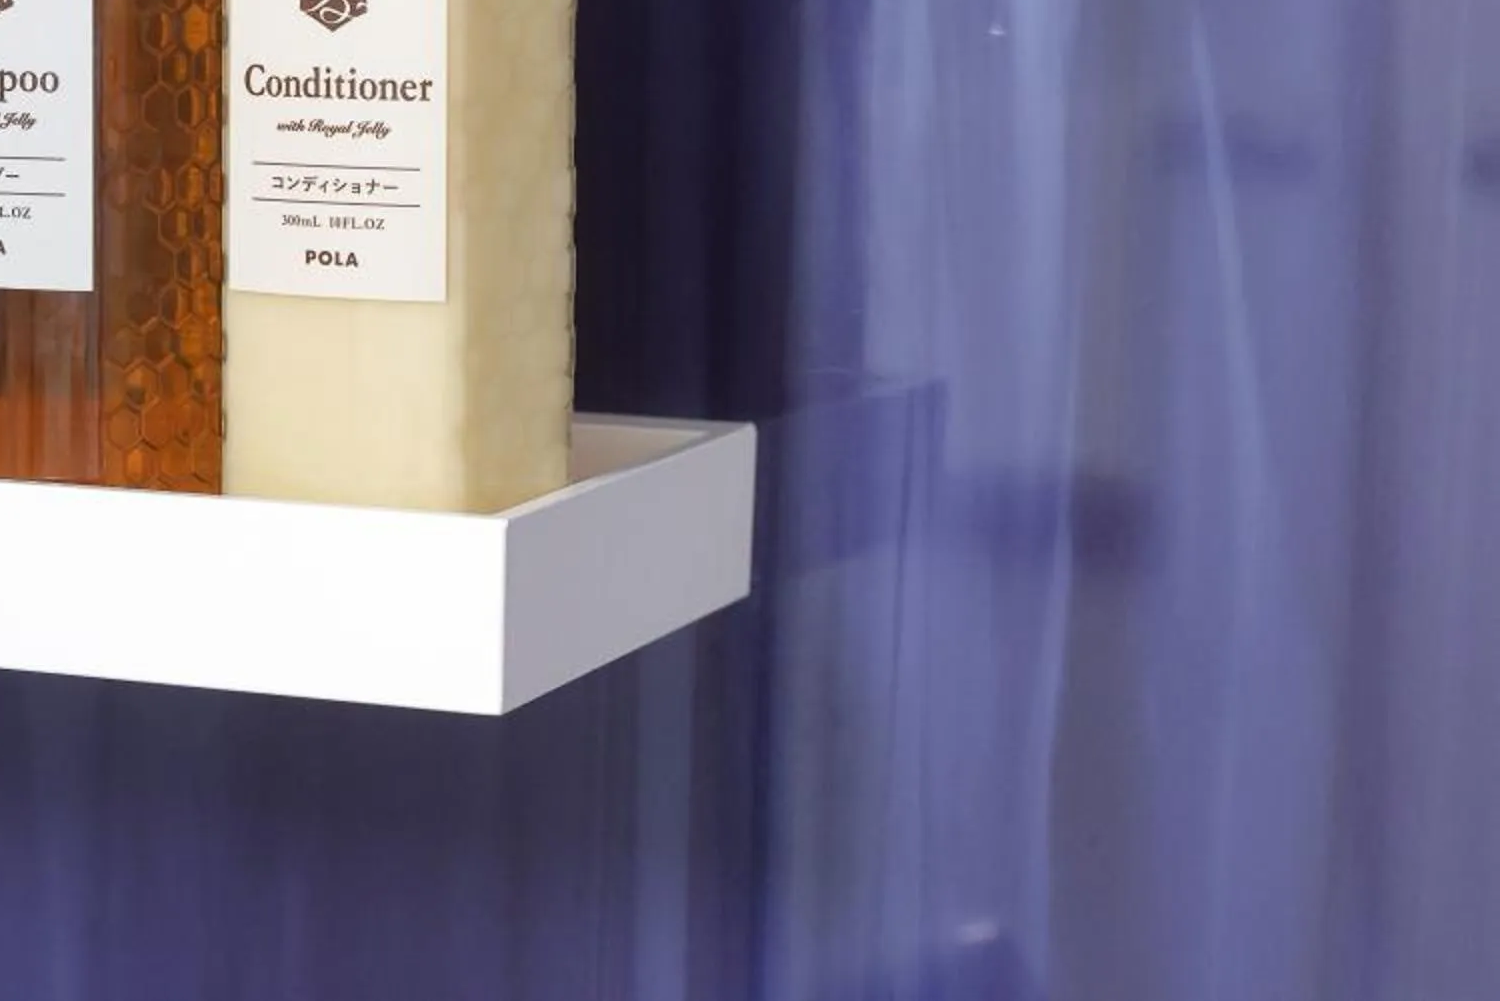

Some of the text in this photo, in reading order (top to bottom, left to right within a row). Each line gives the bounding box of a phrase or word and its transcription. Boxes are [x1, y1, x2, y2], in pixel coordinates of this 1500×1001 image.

[244, 63, 433, 102] Conditioner
[0, 112, 37, 130] Jelly
[276, 118, 391, 140] with Royal Jelly
[271, 175, 399, 195] コンディショナー
[305, 250, 359, 268] POLA
